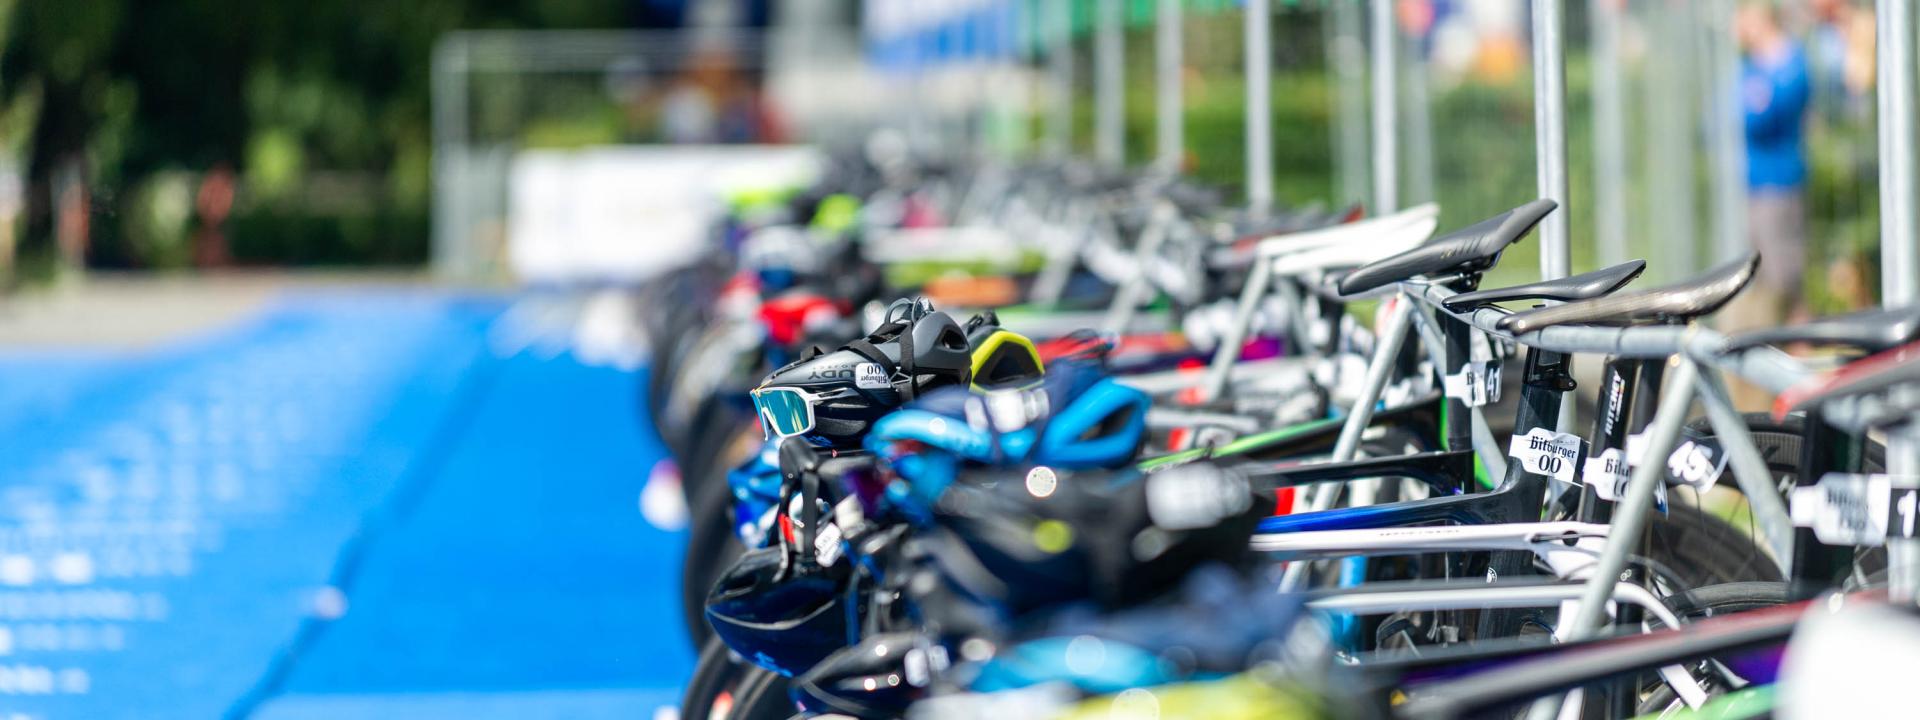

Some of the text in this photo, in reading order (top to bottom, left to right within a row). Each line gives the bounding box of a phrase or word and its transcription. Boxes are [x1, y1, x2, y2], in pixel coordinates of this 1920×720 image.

[808, 369, 855, 380] UDY
[1605, 369, 1622, 435] RITCHEY
[1529, 435, 1577, 459] Bitburger
